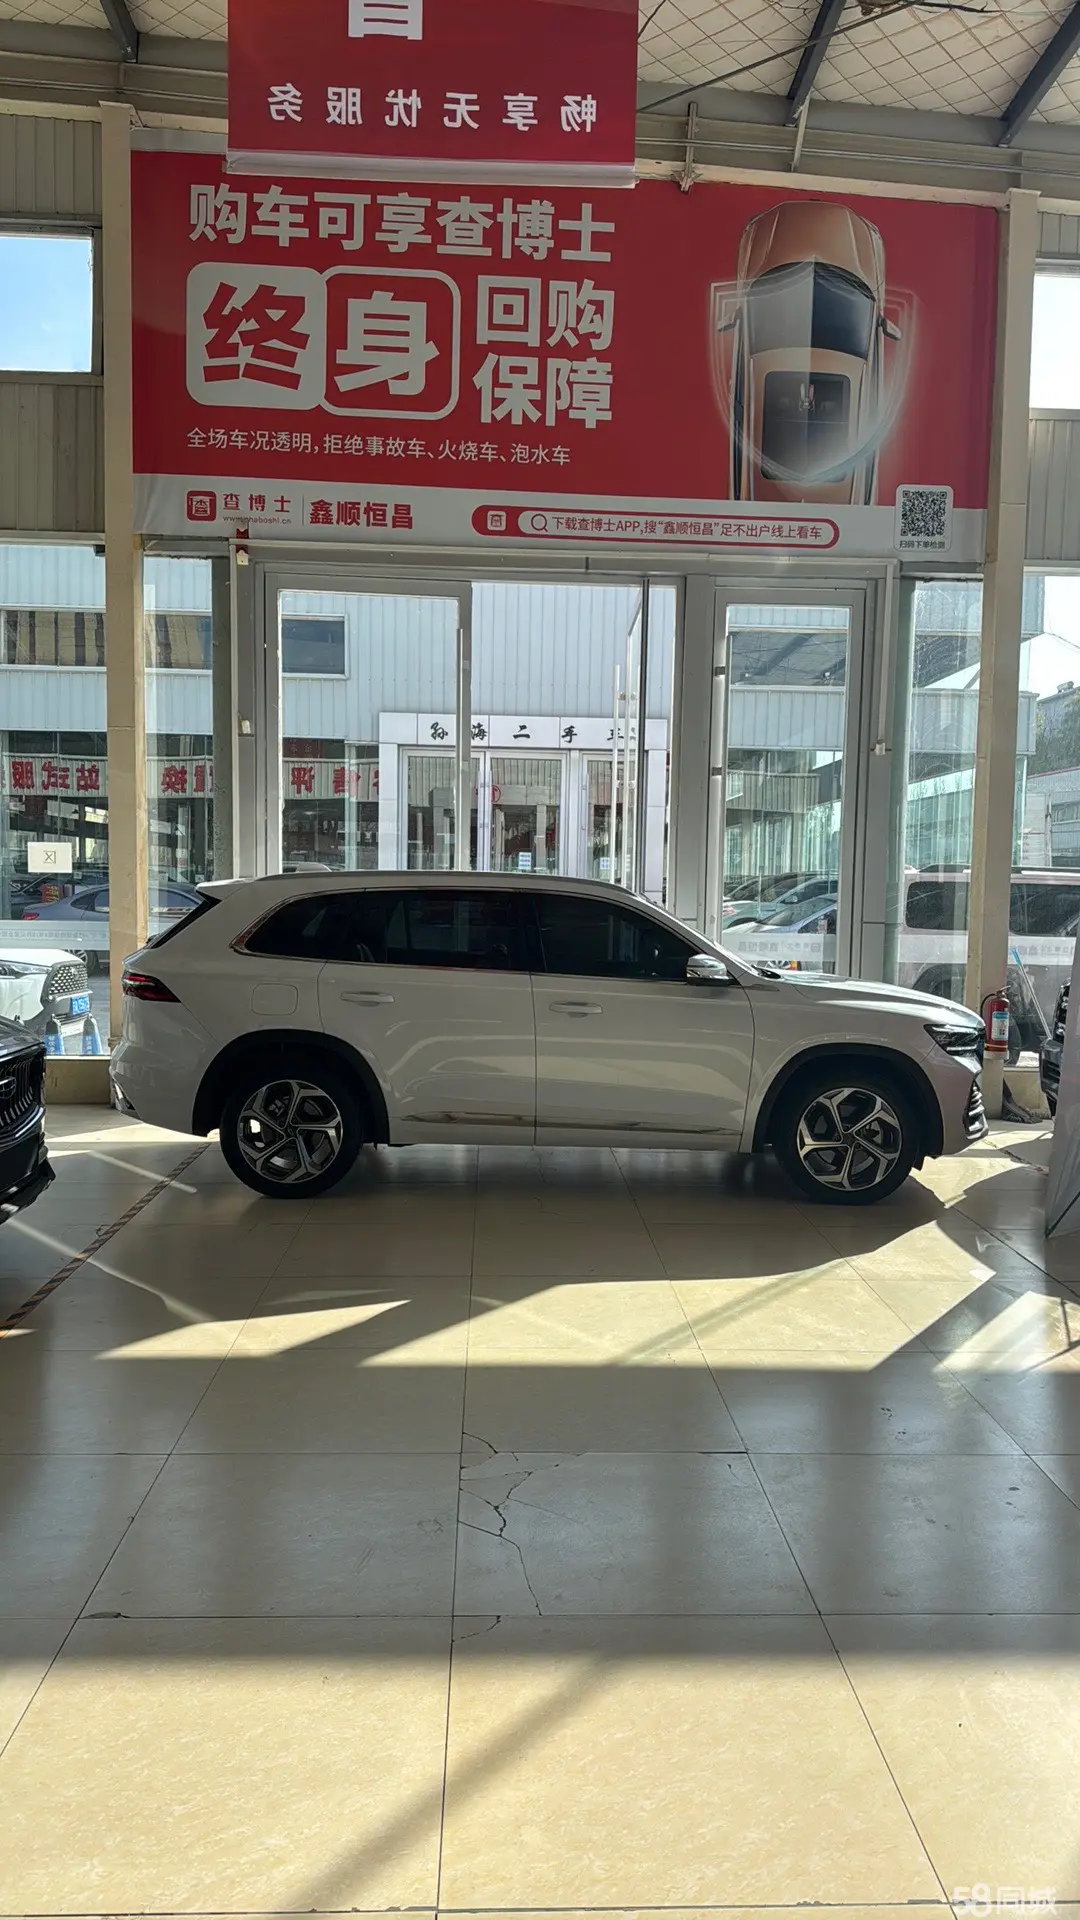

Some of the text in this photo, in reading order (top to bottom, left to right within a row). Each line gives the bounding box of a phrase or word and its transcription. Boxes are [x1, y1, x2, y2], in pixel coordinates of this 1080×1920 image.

[188, 183, 616, 262] 购车可享查博士
[200, 282, 440, 396] 终身
[476, 274, 616, 351] 回购
[472, 352, 614, 429] 保障
[222, 492, 292, 513] 查博士
[309, 498, 413, 530] 鑫顺恒昌
